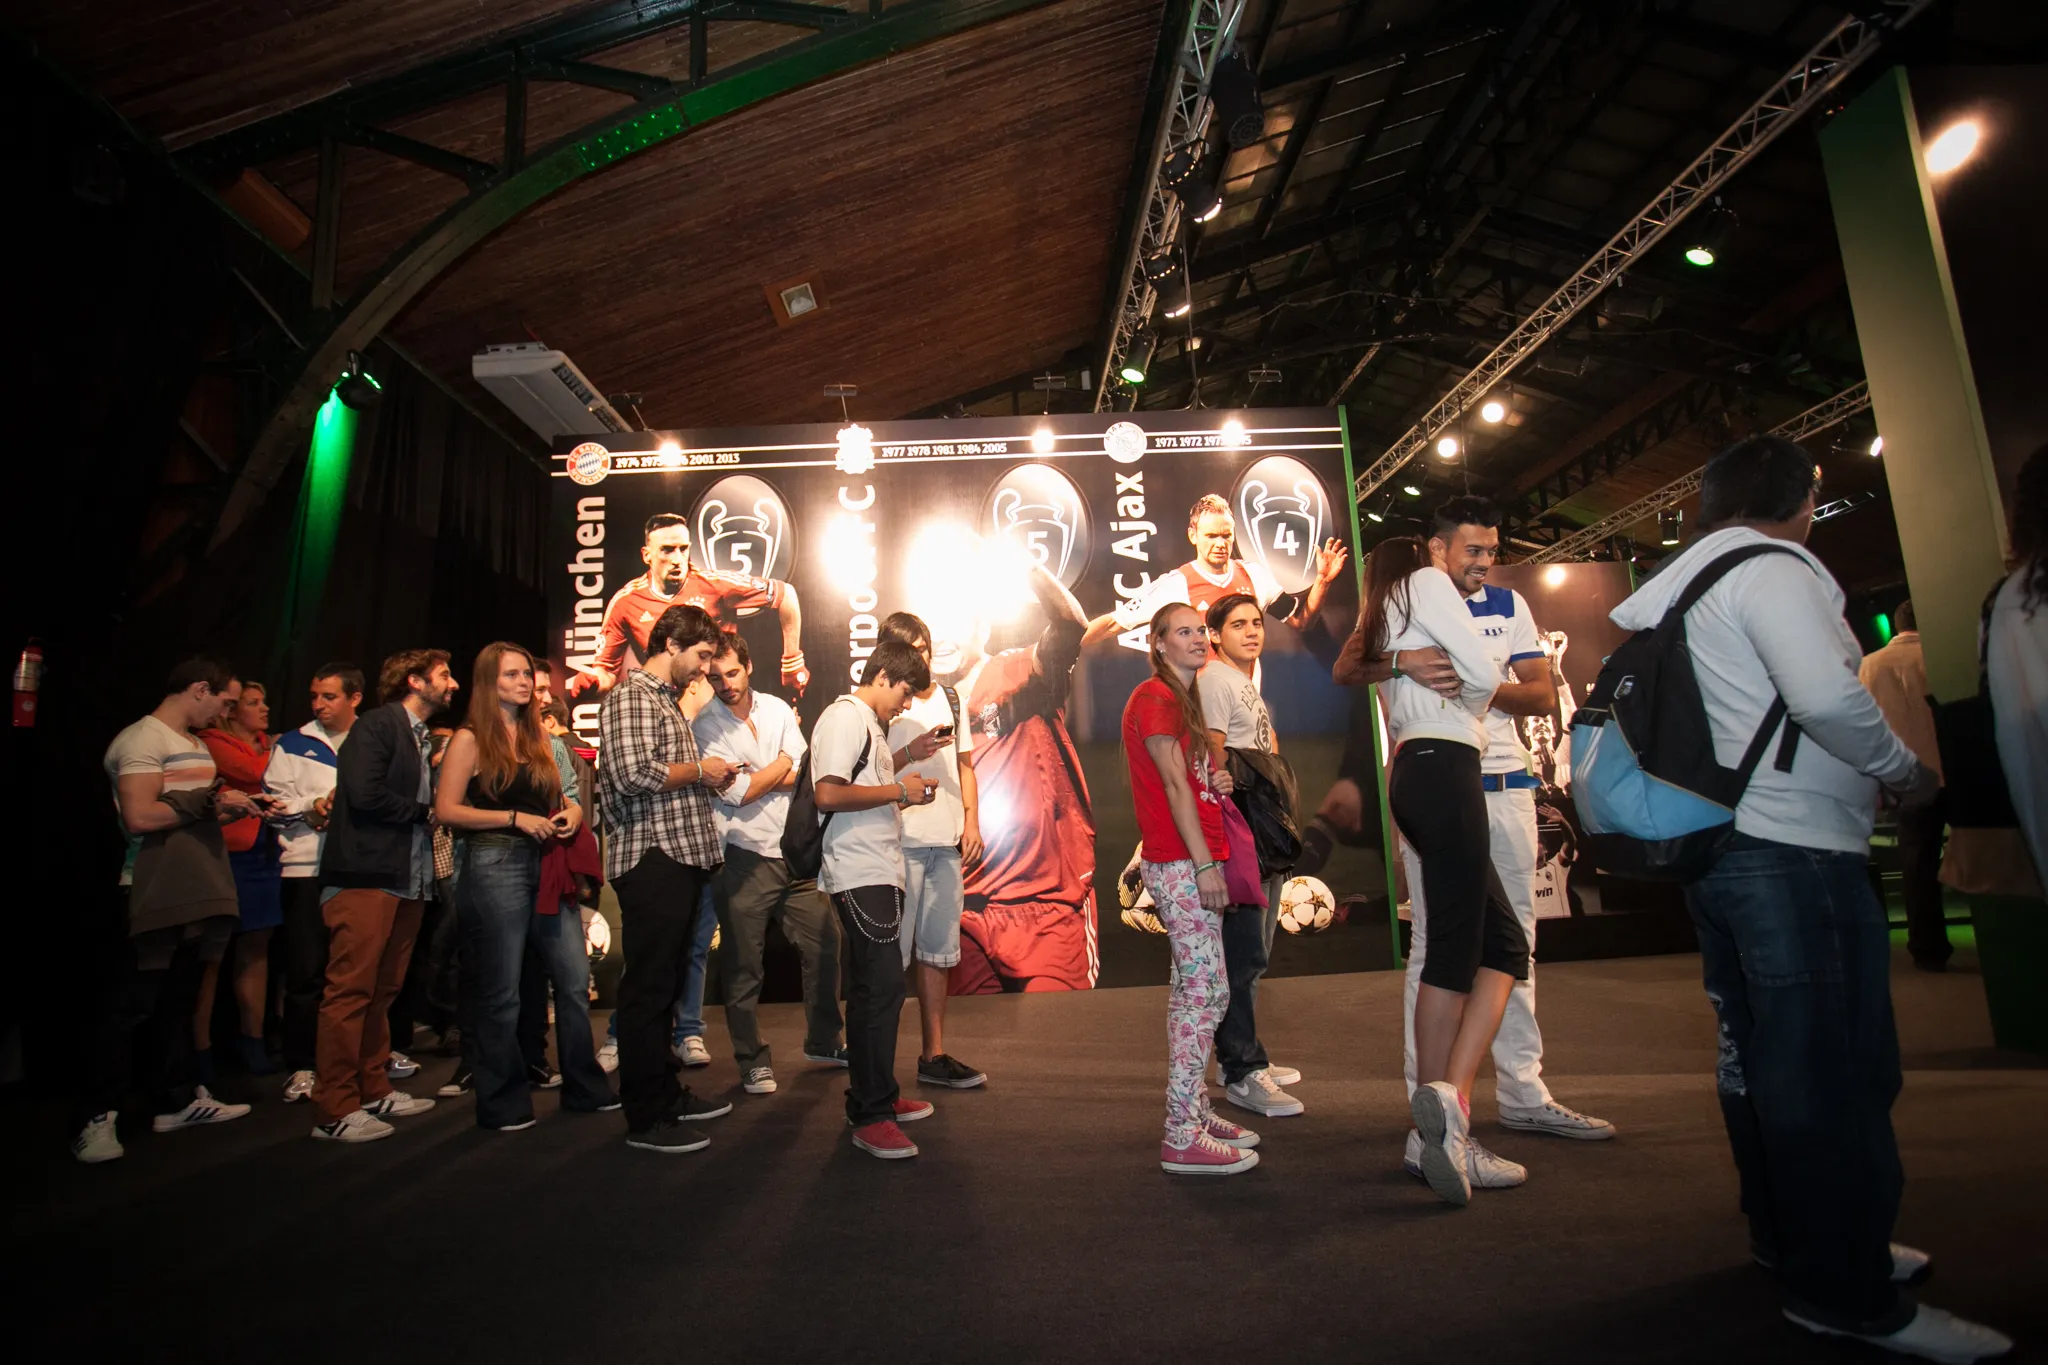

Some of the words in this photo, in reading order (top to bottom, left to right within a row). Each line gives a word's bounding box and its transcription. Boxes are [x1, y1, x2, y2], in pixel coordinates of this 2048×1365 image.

[882, 446, 905, 458] 1977
[907, 445, 930, 457] 1978
[932, 445, 955, 456] 1981
[957, 443, 981, 455] 1984
[982, 442, 1007, 454] 2005
[1155, 437, 1178, 448] 1971
[1180, 436, 1202, 447] 1972
[1204, 435, 1225, 446] 197
[615, 457, 640, 469] 1974
[689, 453, 714, 465] 2001
[715, 452, 740, 464] 2013
[1111, 471, 1157, 562] Ajax
[1026, 530, 1049, 567] 5
[1273, 522, 1299, 556] 4
[730, 542, 752, 575] 5
[565, 496, 605, 690] München
